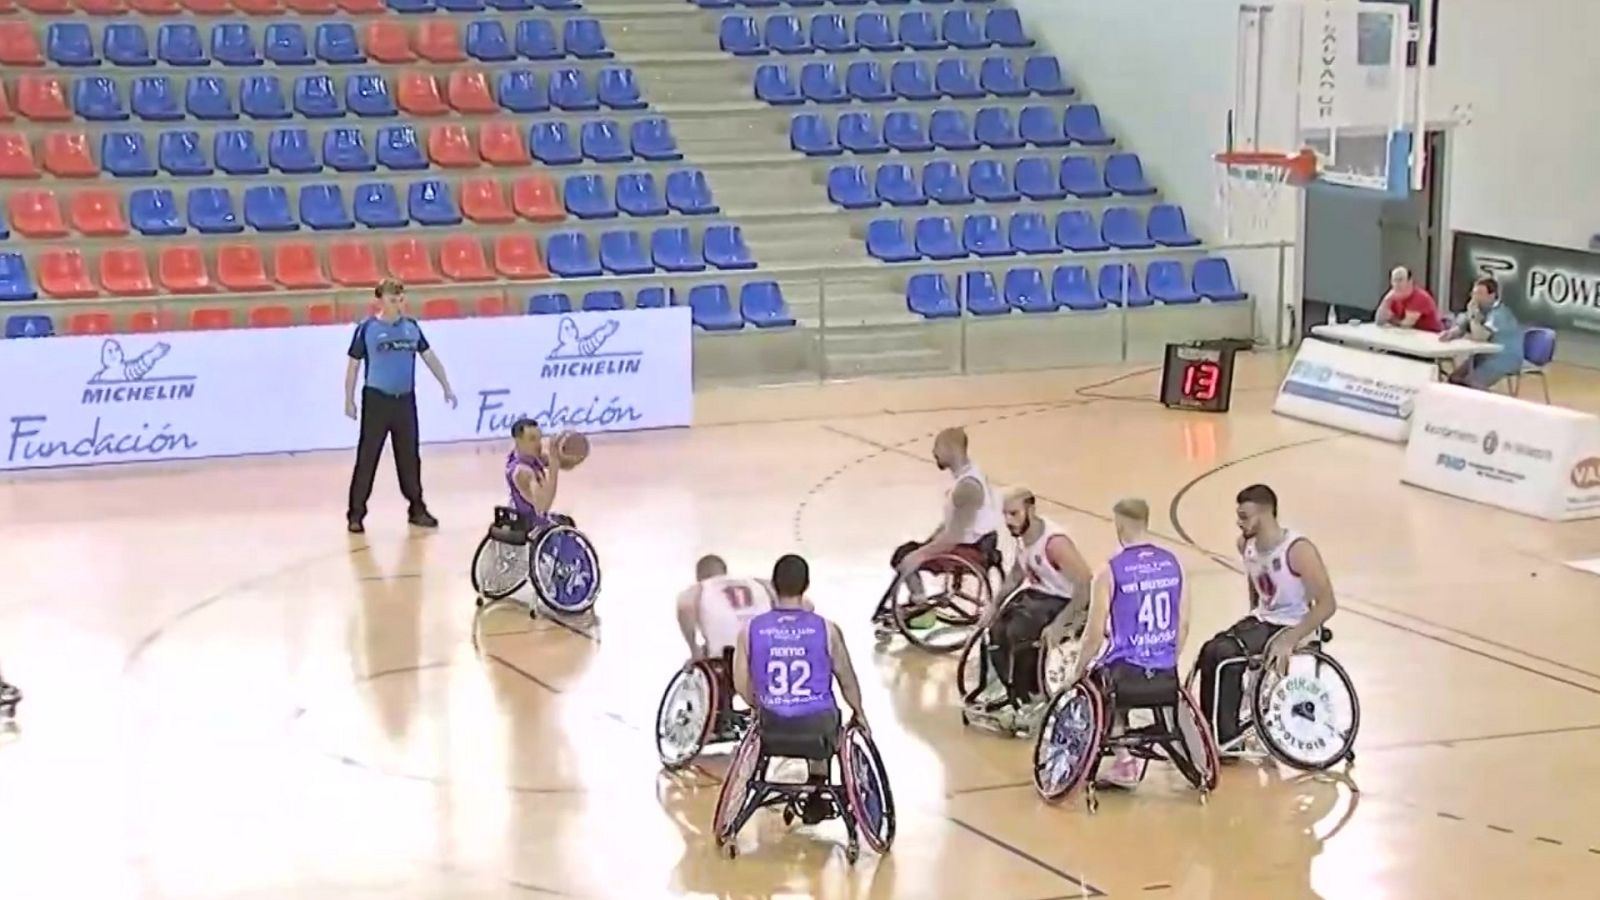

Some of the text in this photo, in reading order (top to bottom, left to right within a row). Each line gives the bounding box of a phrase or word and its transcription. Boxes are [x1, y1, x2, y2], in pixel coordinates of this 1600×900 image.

[540, 358, 641, 378] MICHELIN
[1184, 365, 1219, 400] 13
[81, 383, 195, 404] MICHELIN
[475, 388, 642, 434] Fundación
[9, 415, 198, 461] Fundación
[1138, 591, 1171, 632] 40
[767, 660, 811, 696] 32
